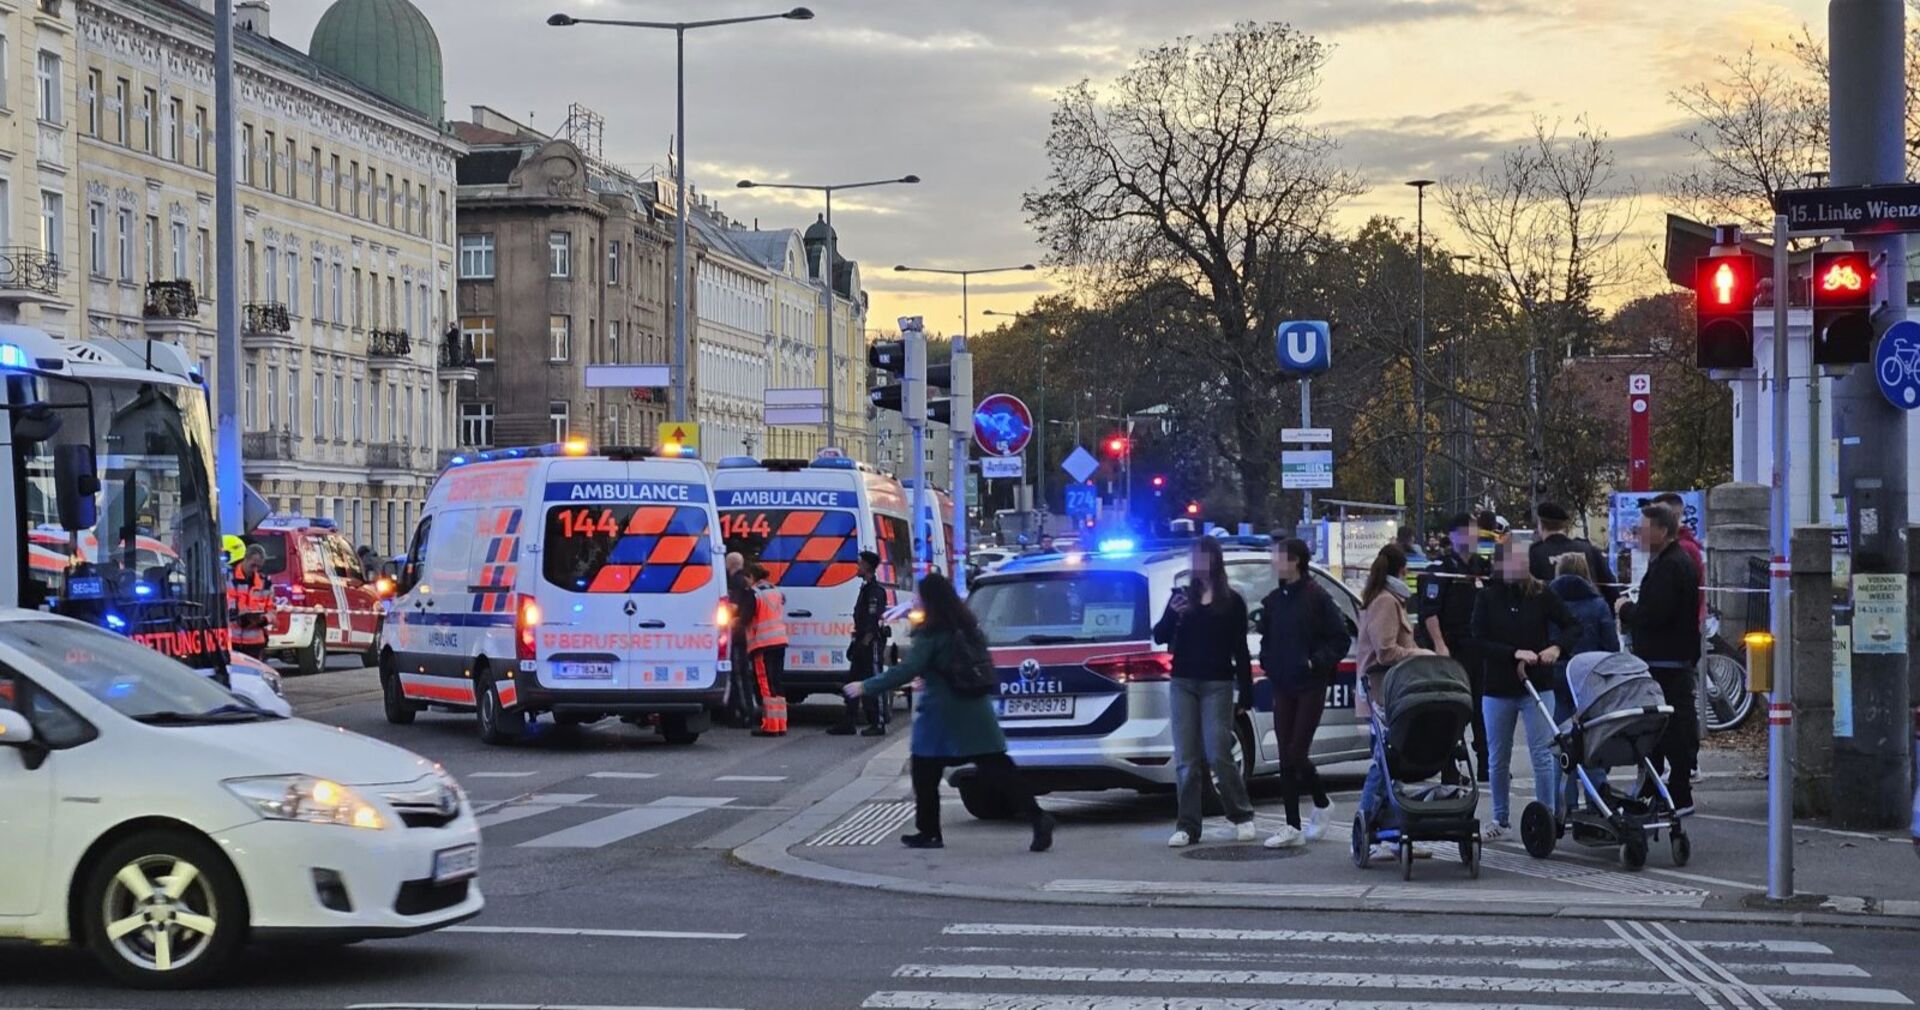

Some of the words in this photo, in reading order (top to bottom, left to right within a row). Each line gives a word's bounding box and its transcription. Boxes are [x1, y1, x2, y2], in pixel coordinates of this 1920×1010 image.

[1818, 202, 1862, 221] Linke
[1287, 331, 1317, 364] U
[571, 483, 689, 500] AMBULANCE
[731, 491, 838, 506] AMBULANCE
[558, 508, 619, 538] 144
[720, 513, 771, 539] 144
[131, 629, 201, 656] RETTUNG
[559, 633, 713, 649] BERUFSRETTUNG
[597, 664, 609, 674] MA
[1000, 680, 1063, 695] POLIZEI
[1008, 700, 1022, 713] BP
[1031, 698, 1067, 712] 90978
